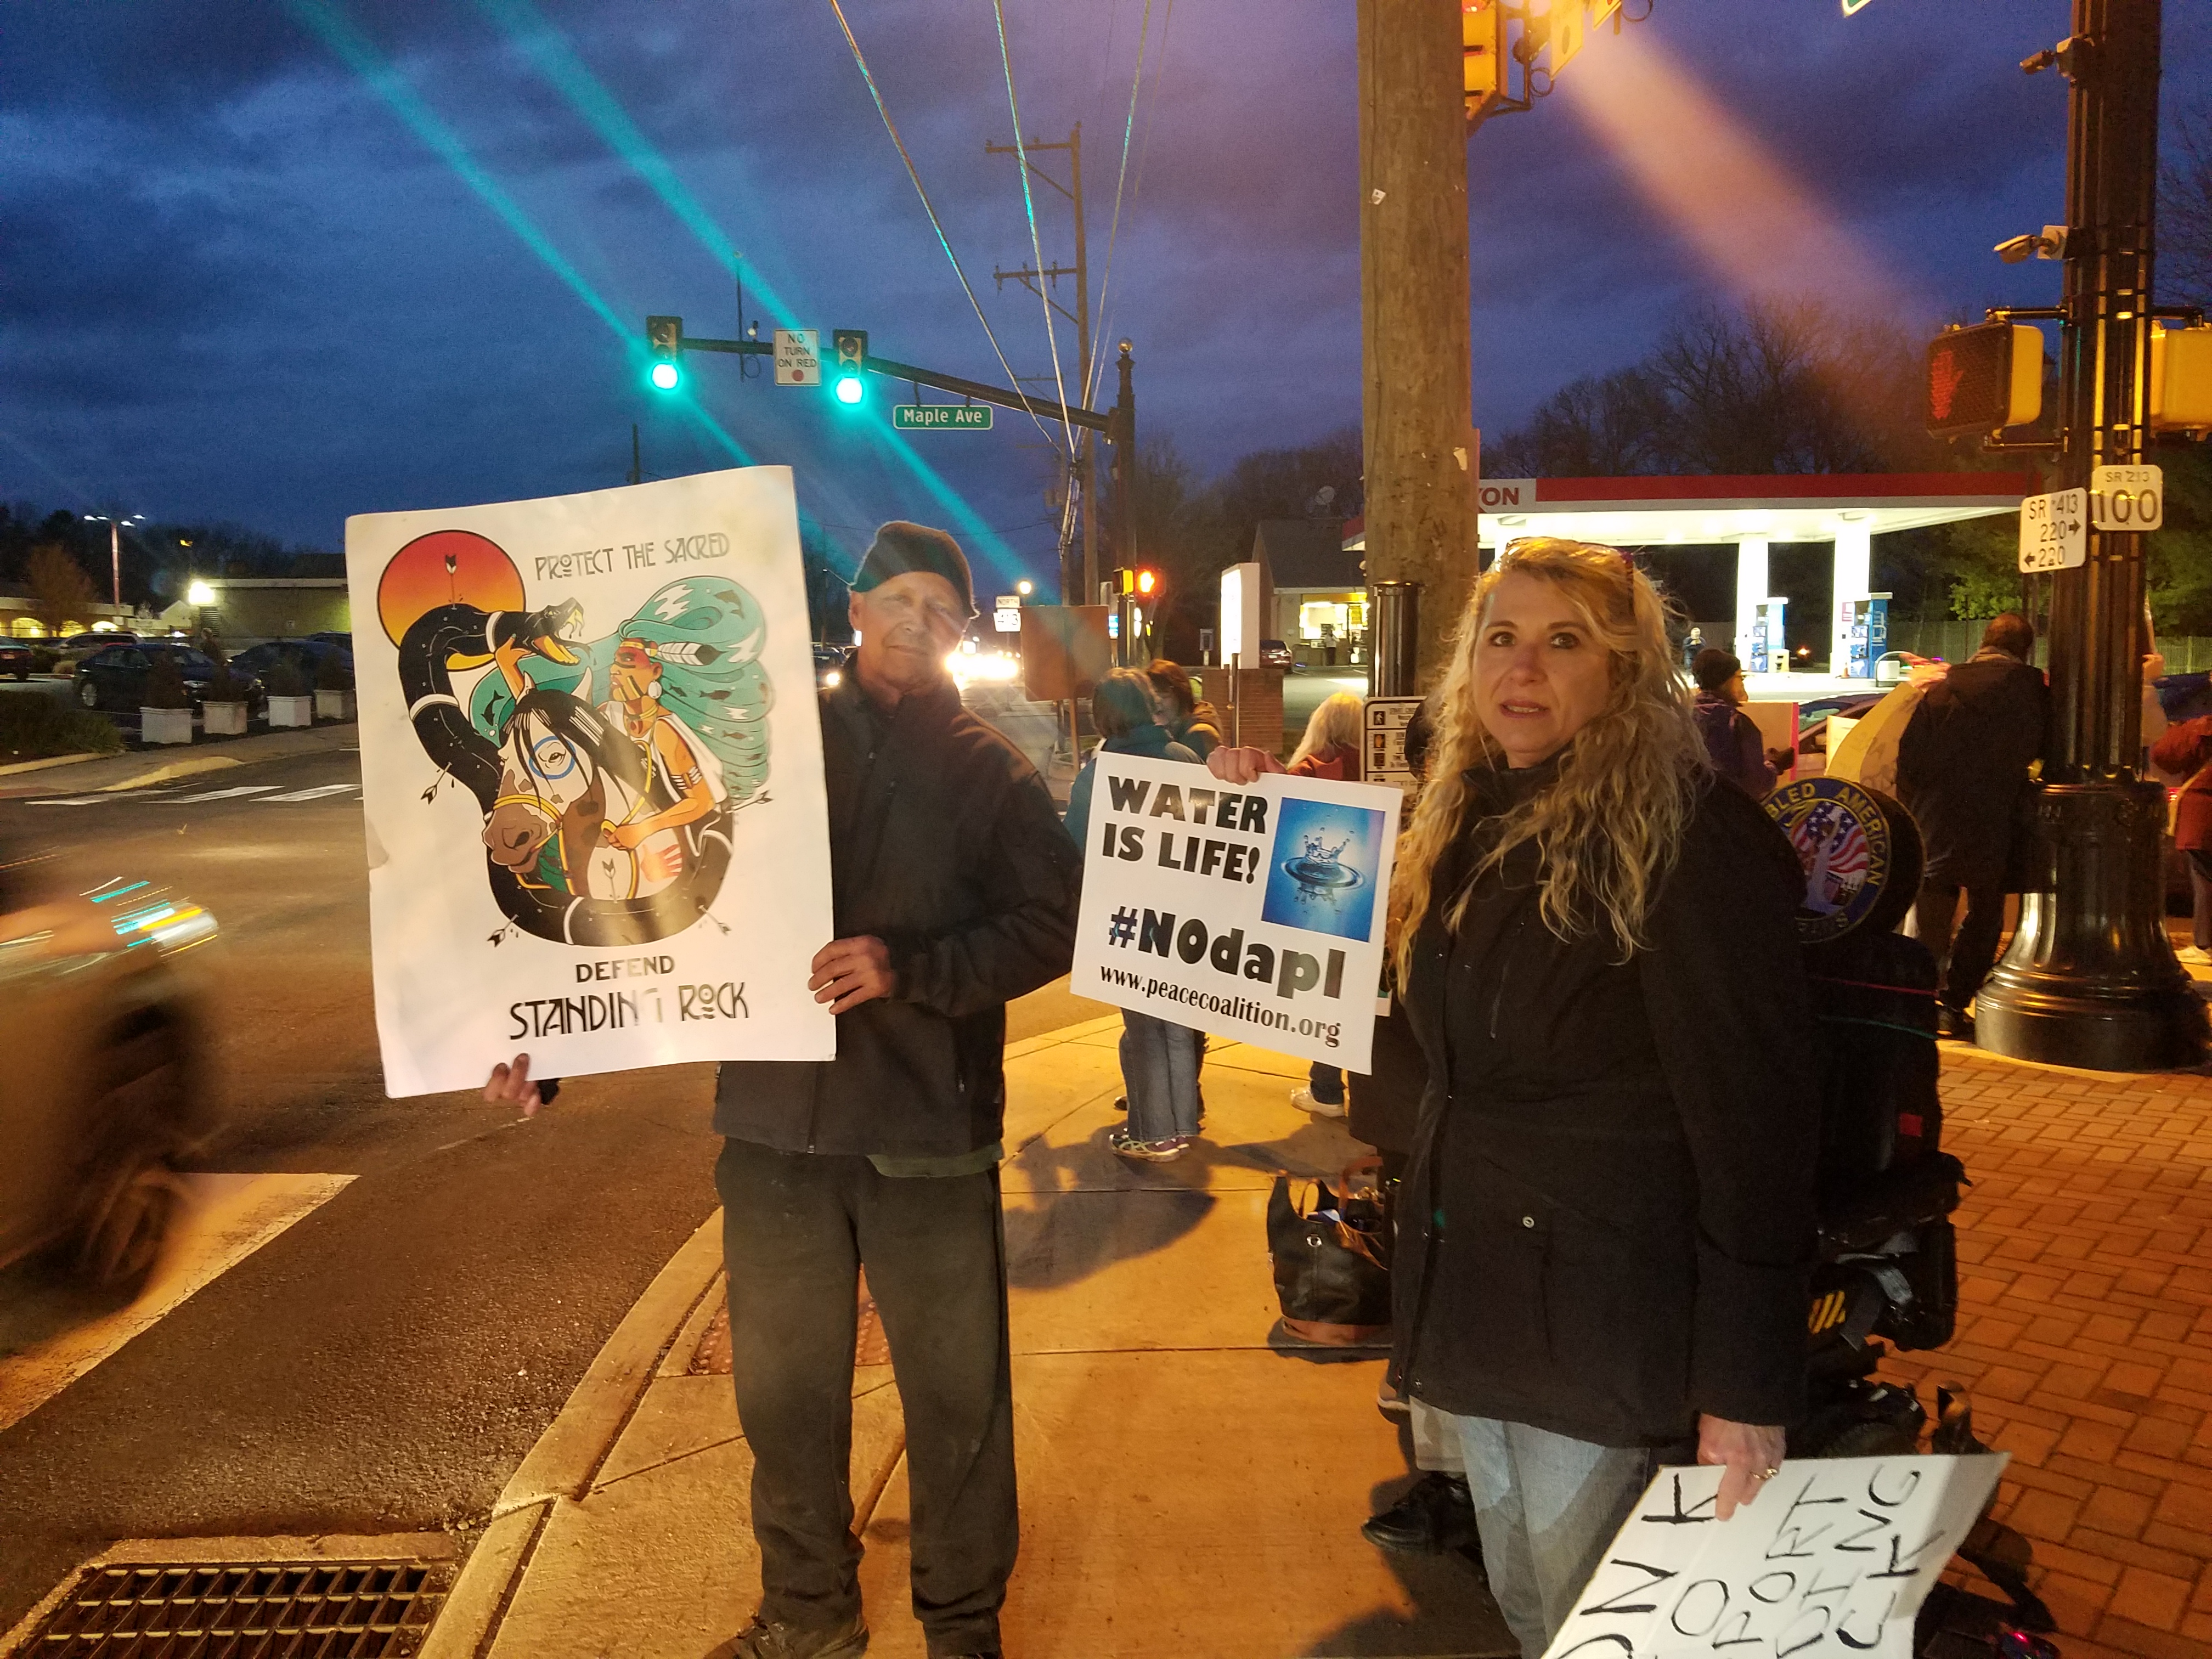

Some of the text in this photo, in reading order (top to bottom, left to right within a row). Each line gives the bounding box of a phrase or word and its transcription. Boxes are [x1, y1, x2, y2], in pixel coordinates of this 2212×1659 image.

[785, 347, 810, 356] TURN
[788, 334, 805, 343] NO
[778, 359, 817, 367] ON RED
[904, 409, 982, 426] Maple Ave
[2105, 472, 2123, 482] SR
[1479, 487, 1519, 506] ON
[2029, 494, 2078, 520] SR 413
[2098, 489, 2159, 523] 100
[2040, 520, 2067, 543] 220
[535, 532, 730, 580] PROTECT THE SACRED
[1108, 776, 1268, 834] WATER
[1835, 786, 1886, 886] AMERICAN
[1102, 823, 1260, 884] IS LIFE!
[1108, 906, 1347, 1000] #NOdapl
[575, 955, 676, 983] DEFEND
[678, 981, 750, 1022] ROCK
[1100, 965, 1342, 1048] www.peacecoalition.org
